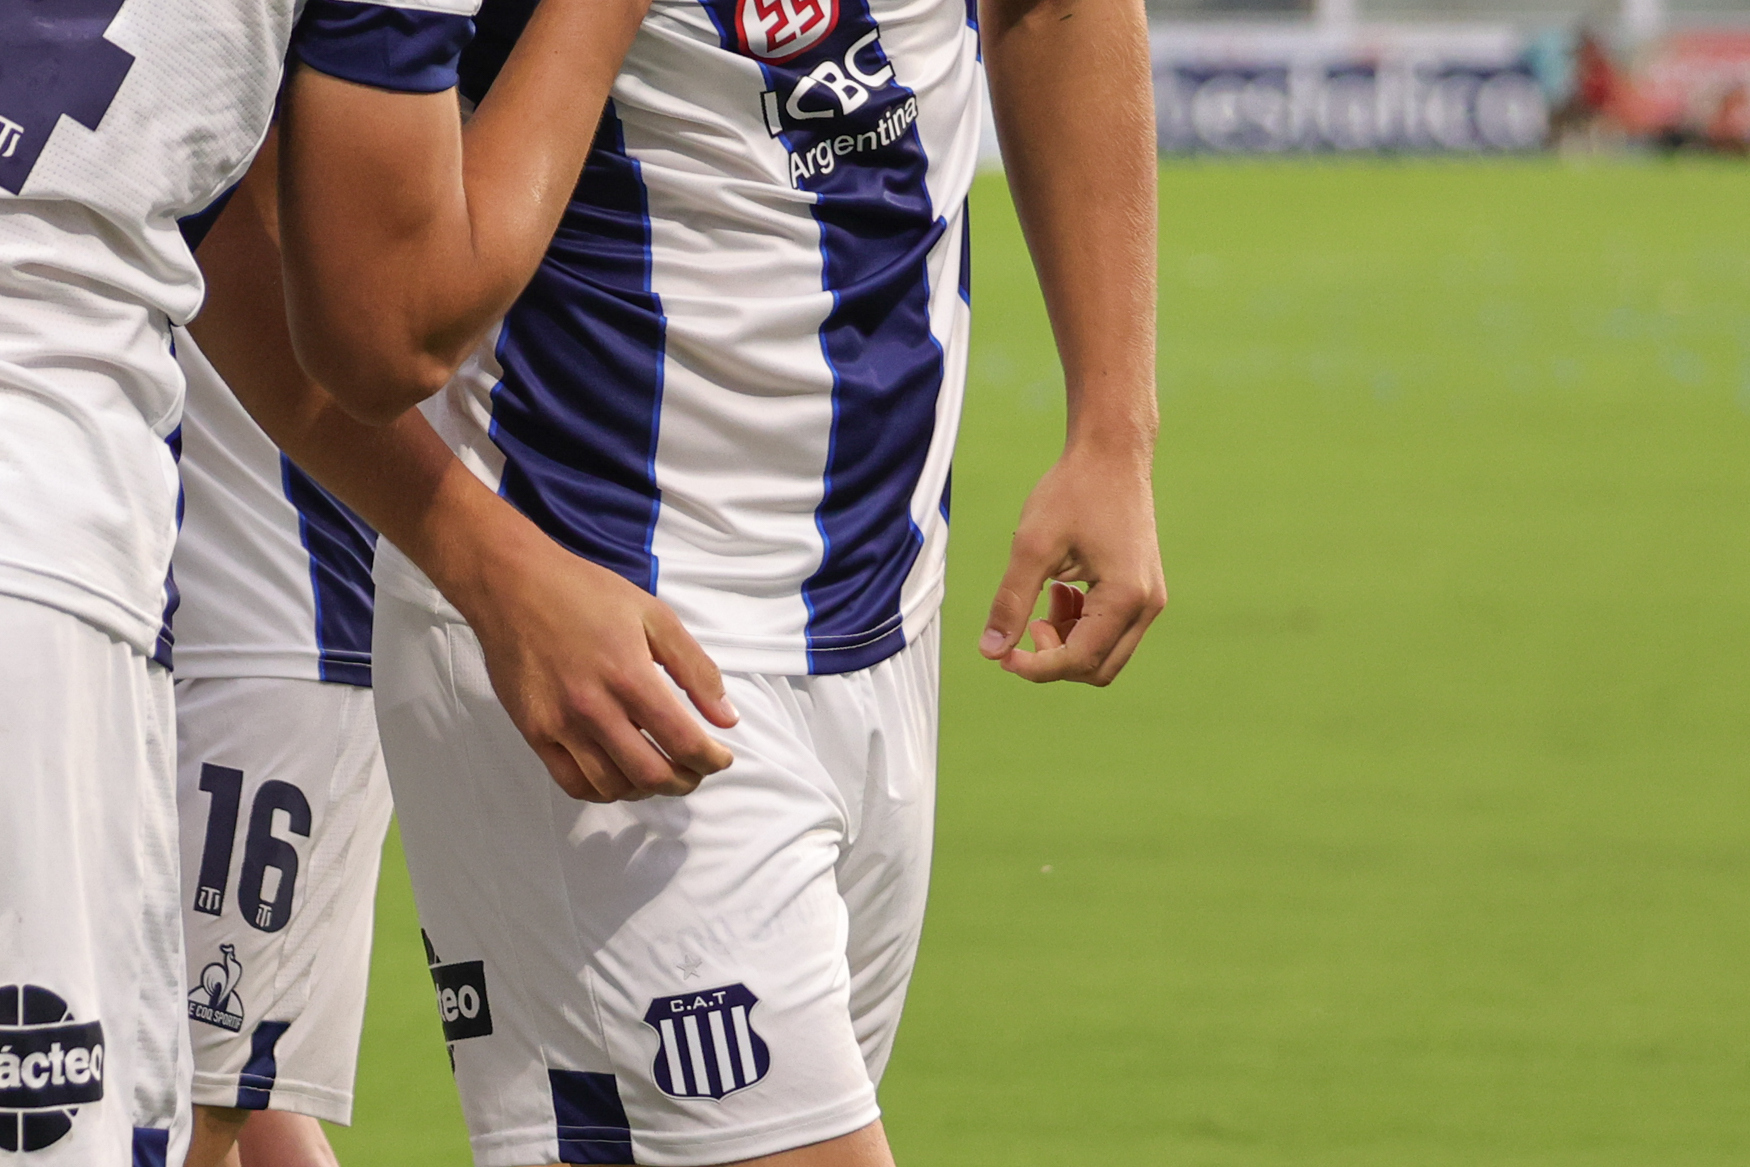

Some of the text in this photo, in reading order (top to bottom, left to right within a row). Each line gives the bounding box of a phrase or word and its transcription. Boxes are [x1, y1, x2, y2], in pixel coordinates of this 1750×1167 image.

[762, 26, 894, 136] ICBC
[791, 95, 918, 189] Argentina
[194, 762, 312, 933] 16
[189, 1002, 196, 1016] E
[670, 991, 726, 1012] C.A.T
